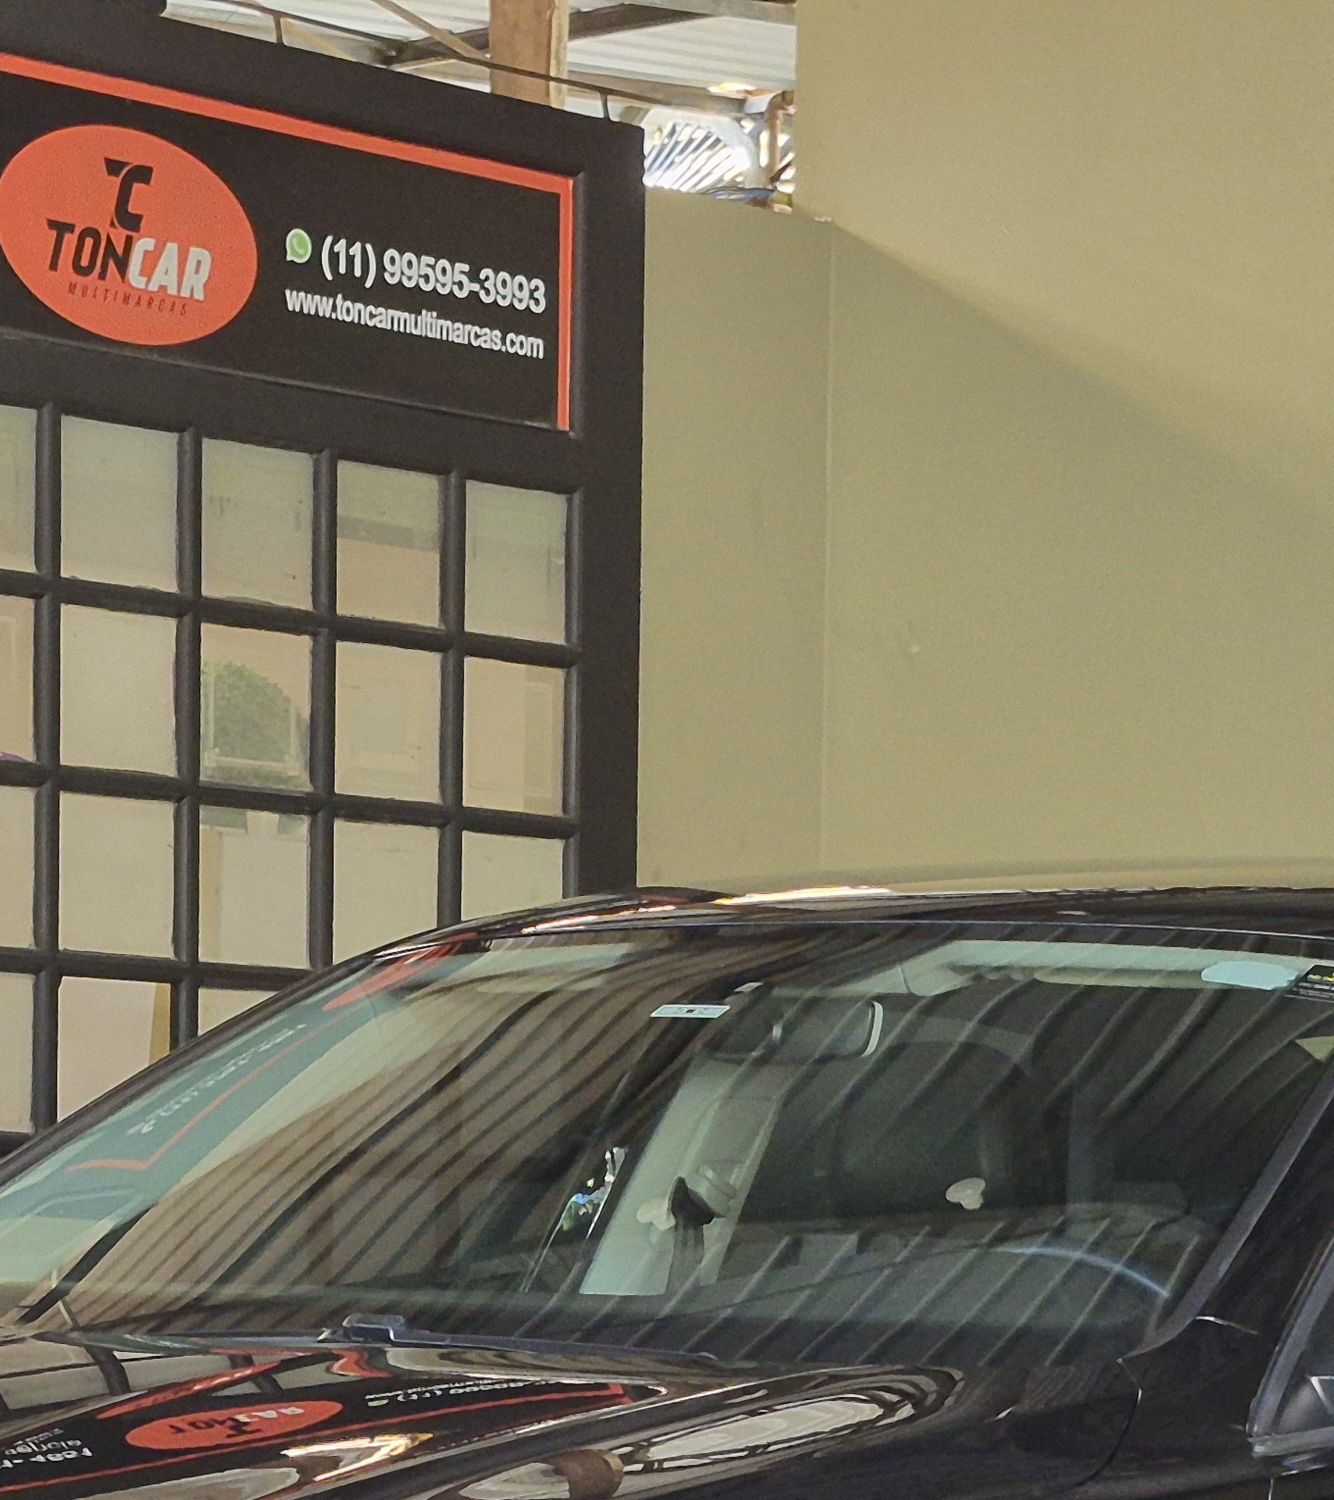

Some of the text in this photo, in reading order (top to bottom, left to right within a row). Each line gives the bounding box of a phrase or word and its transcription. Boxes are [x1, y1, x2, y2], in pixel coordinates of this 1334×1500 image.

[46, 218, 212, 301] TONCAR
[321, 235, 546, 313] (11) 99595-3993
[68, 281, 187, 316] MULTIMARCAS
[285, 289, 544, 359] www.toncarmultimarcas.com
